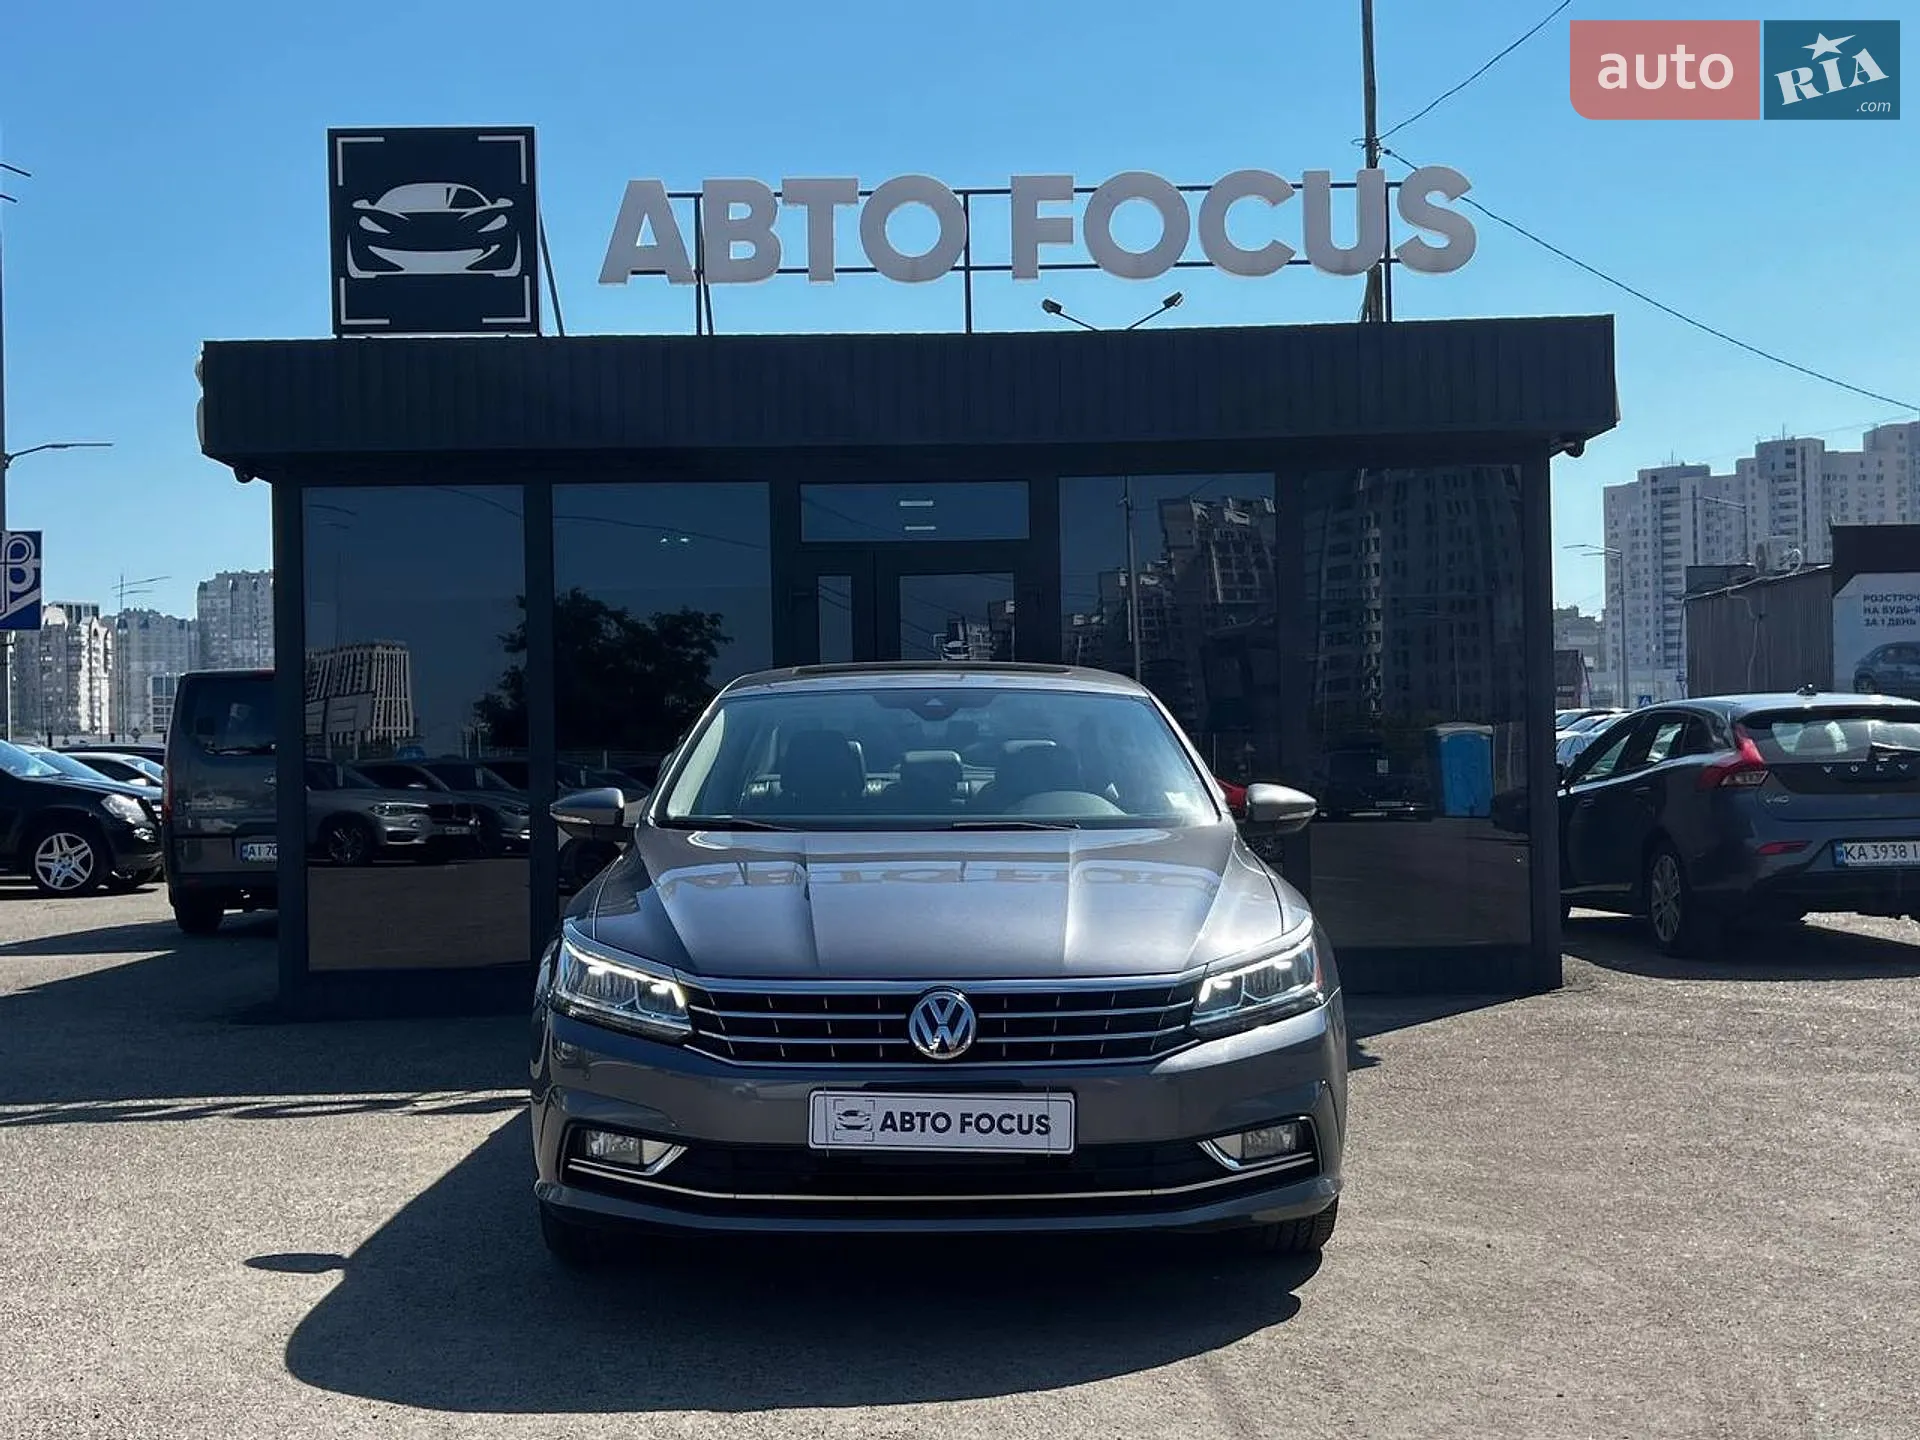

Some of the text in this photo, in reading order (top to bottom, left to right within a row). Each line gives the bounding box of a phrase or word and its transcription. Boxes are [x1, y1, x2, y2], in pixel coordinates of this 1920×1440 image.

[598, 165, 1478, 285] АВТО FOCUS
[1844, 845, 1868, 860] KA
[1872, 844, 1908, 860] 3938
[879, 1111, 1051, 1135] АВТО FOCUS
